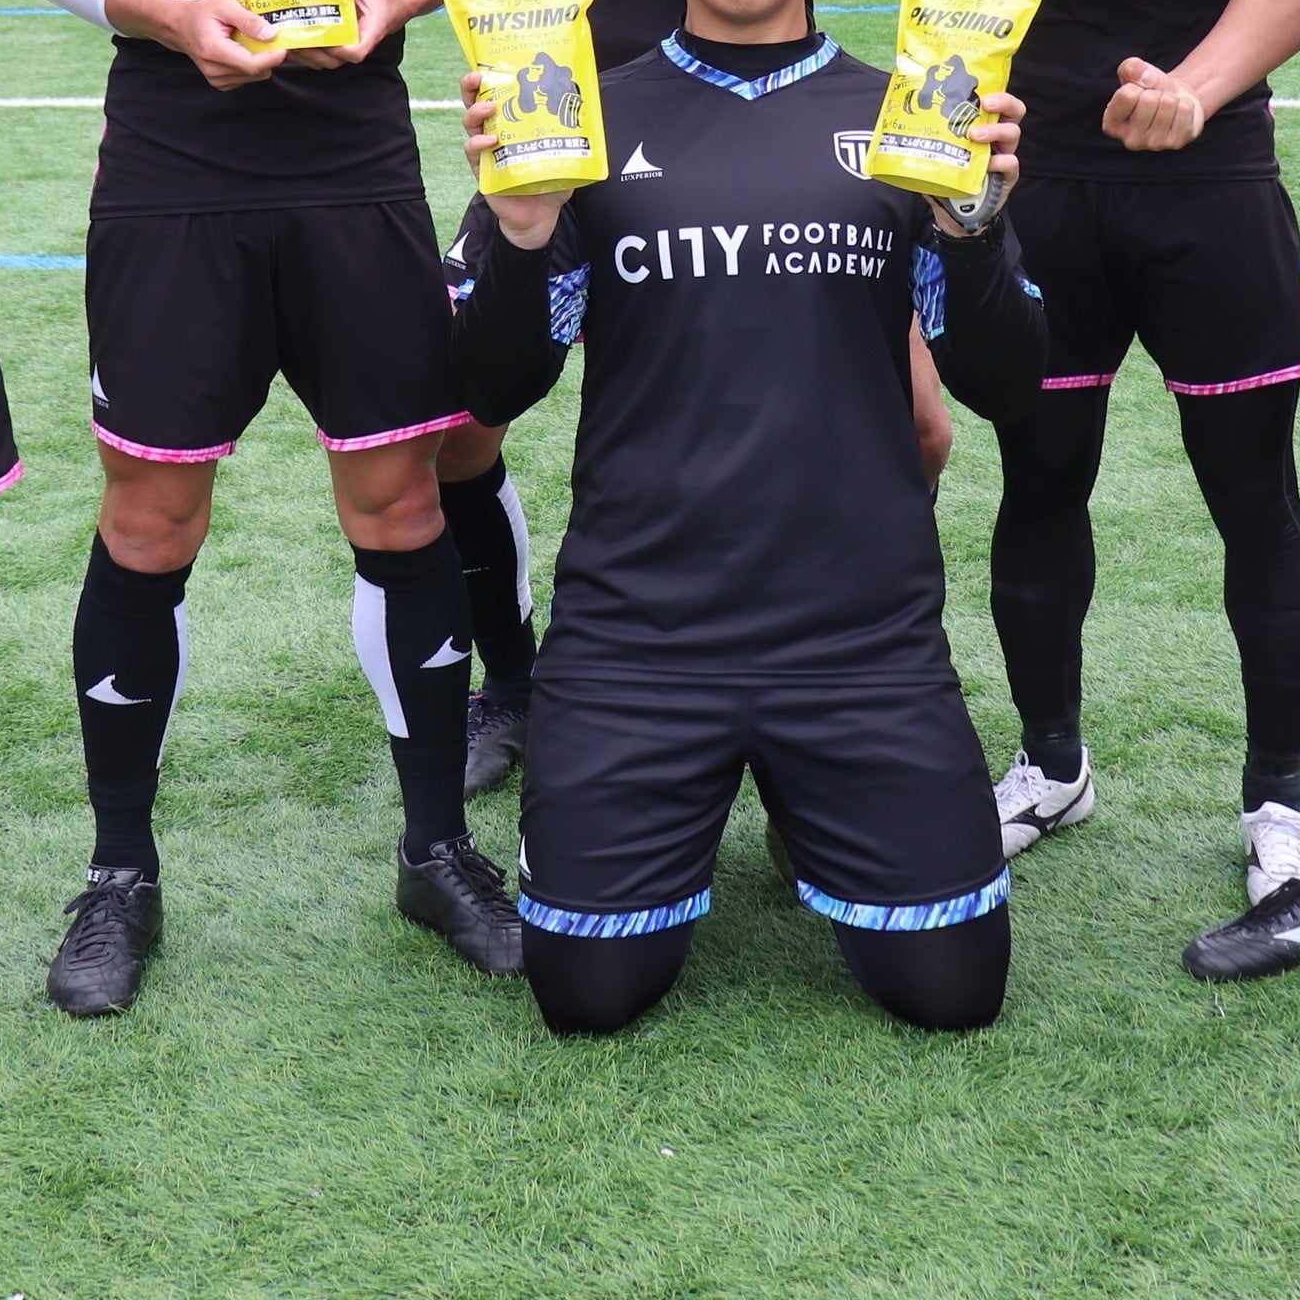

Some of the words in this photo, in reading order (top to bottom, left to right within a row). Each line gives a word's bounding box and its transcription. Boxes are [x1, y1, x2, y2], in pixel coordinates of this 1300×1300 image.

[468, 3, 580, 35] PHYSIIMO
[910, 7, 1014, 39] PHYSIIMO
[620, 171, 663, 182] LUXPERIOR
[763, 222, 894, 252] FOOTBALL
[614, 225, 749, 284] CITY
[765, 252, 886, 279] ACADEMY
